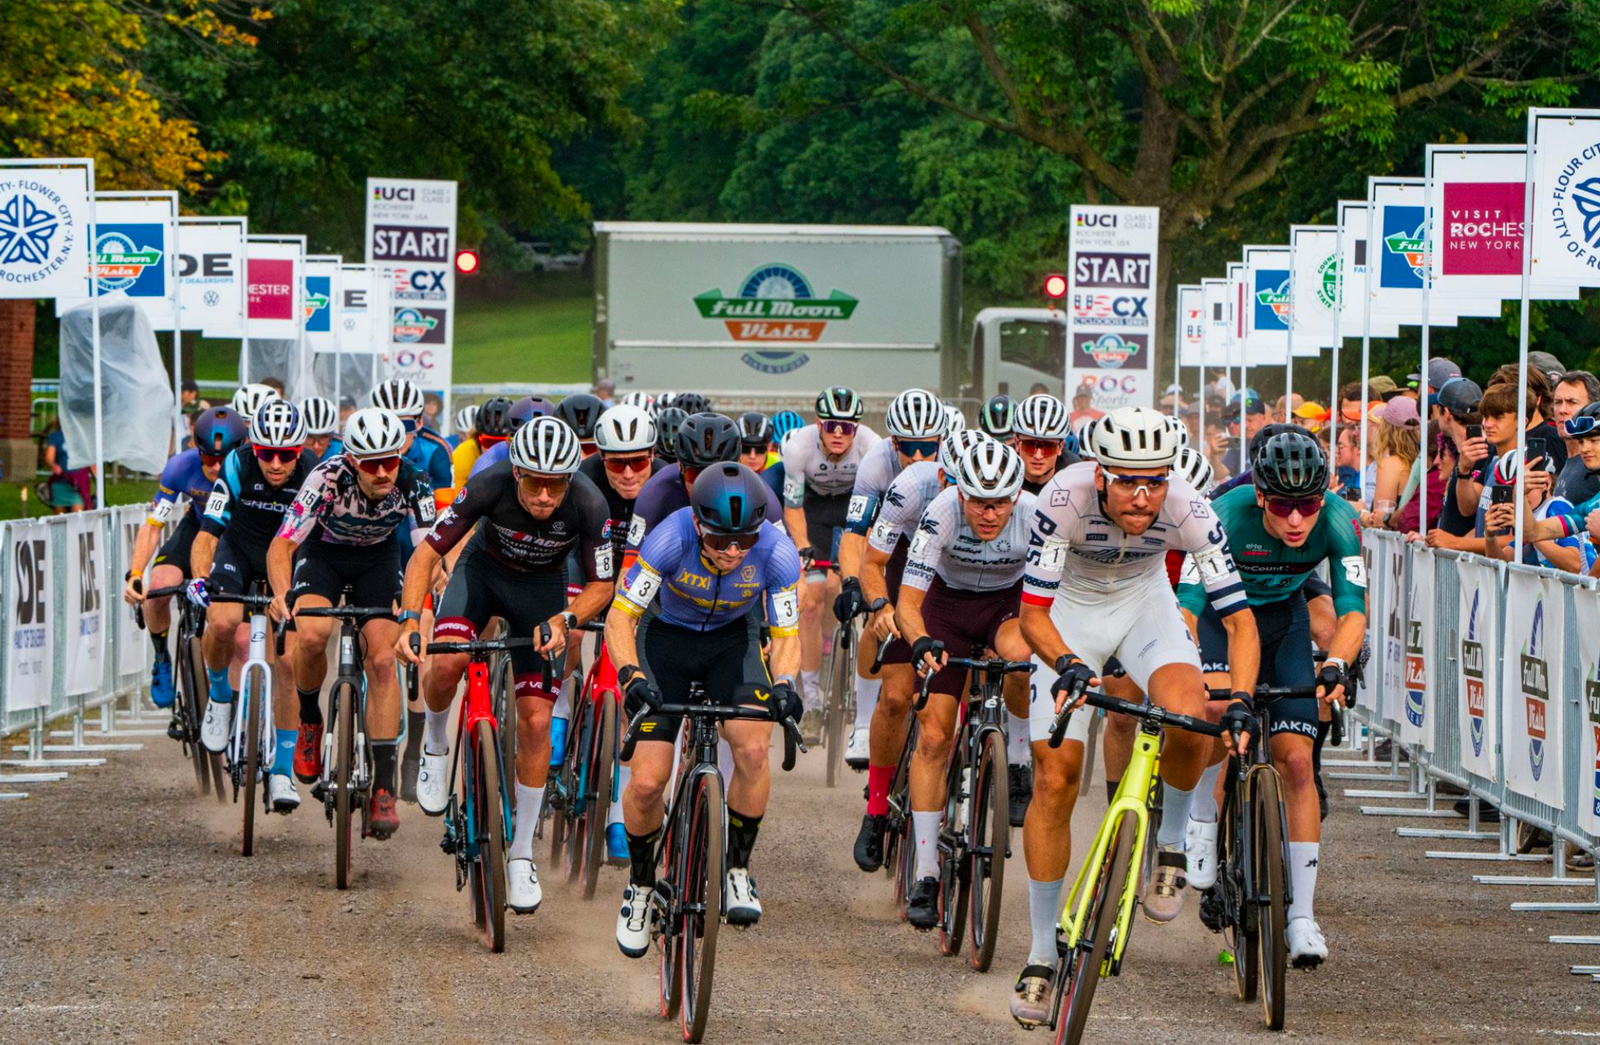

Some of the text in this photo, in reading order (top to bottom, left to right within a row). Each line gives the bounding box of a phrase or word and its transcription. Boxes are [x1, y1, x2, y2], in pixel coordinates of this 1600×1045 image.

[1553, 157, 1583, 200] FLOUR
[382, 187, 415, 201] UCI
[18, 179, 61, 205] FLOWER
[58, 204, 73, 227] CITY
[1085, 214, 1118, 228] UCI
[1451, 210, 1501, 219] VISIT
[1552, 207, 1586, 258] CITY OF
[374, 229, 449, 258] START
[1450, 241, 1520, 250] NEW YORK
[1076, 257, 1150, 284] START
[247, 284, 291, 296] ESTER
[710, 300, 844, 318] Full Moon
[739, 323, 812, 338] Vista
[210, 499, 223, 512] 10
[302, 490, 316, 506] 15
[159, 505, 171, 518] 17
[422, 502, 435, 516] 15
[850, 502, 862, 515] 34
[630, 524, 638, 538] 4
[877, 525, 885, 538] 6
[912, 537, 921, 554] 2
[1053, 546, 1060, 563] 1
[603, 556, 611, 571] 8
[1186, 561, 1198, 577] 7
[1208, 557, 1219, 574] 1
[638, 580, 652, 598] 3
[783, 600, 793, 618] 3
[434, 622, 470, 633] VERGE
